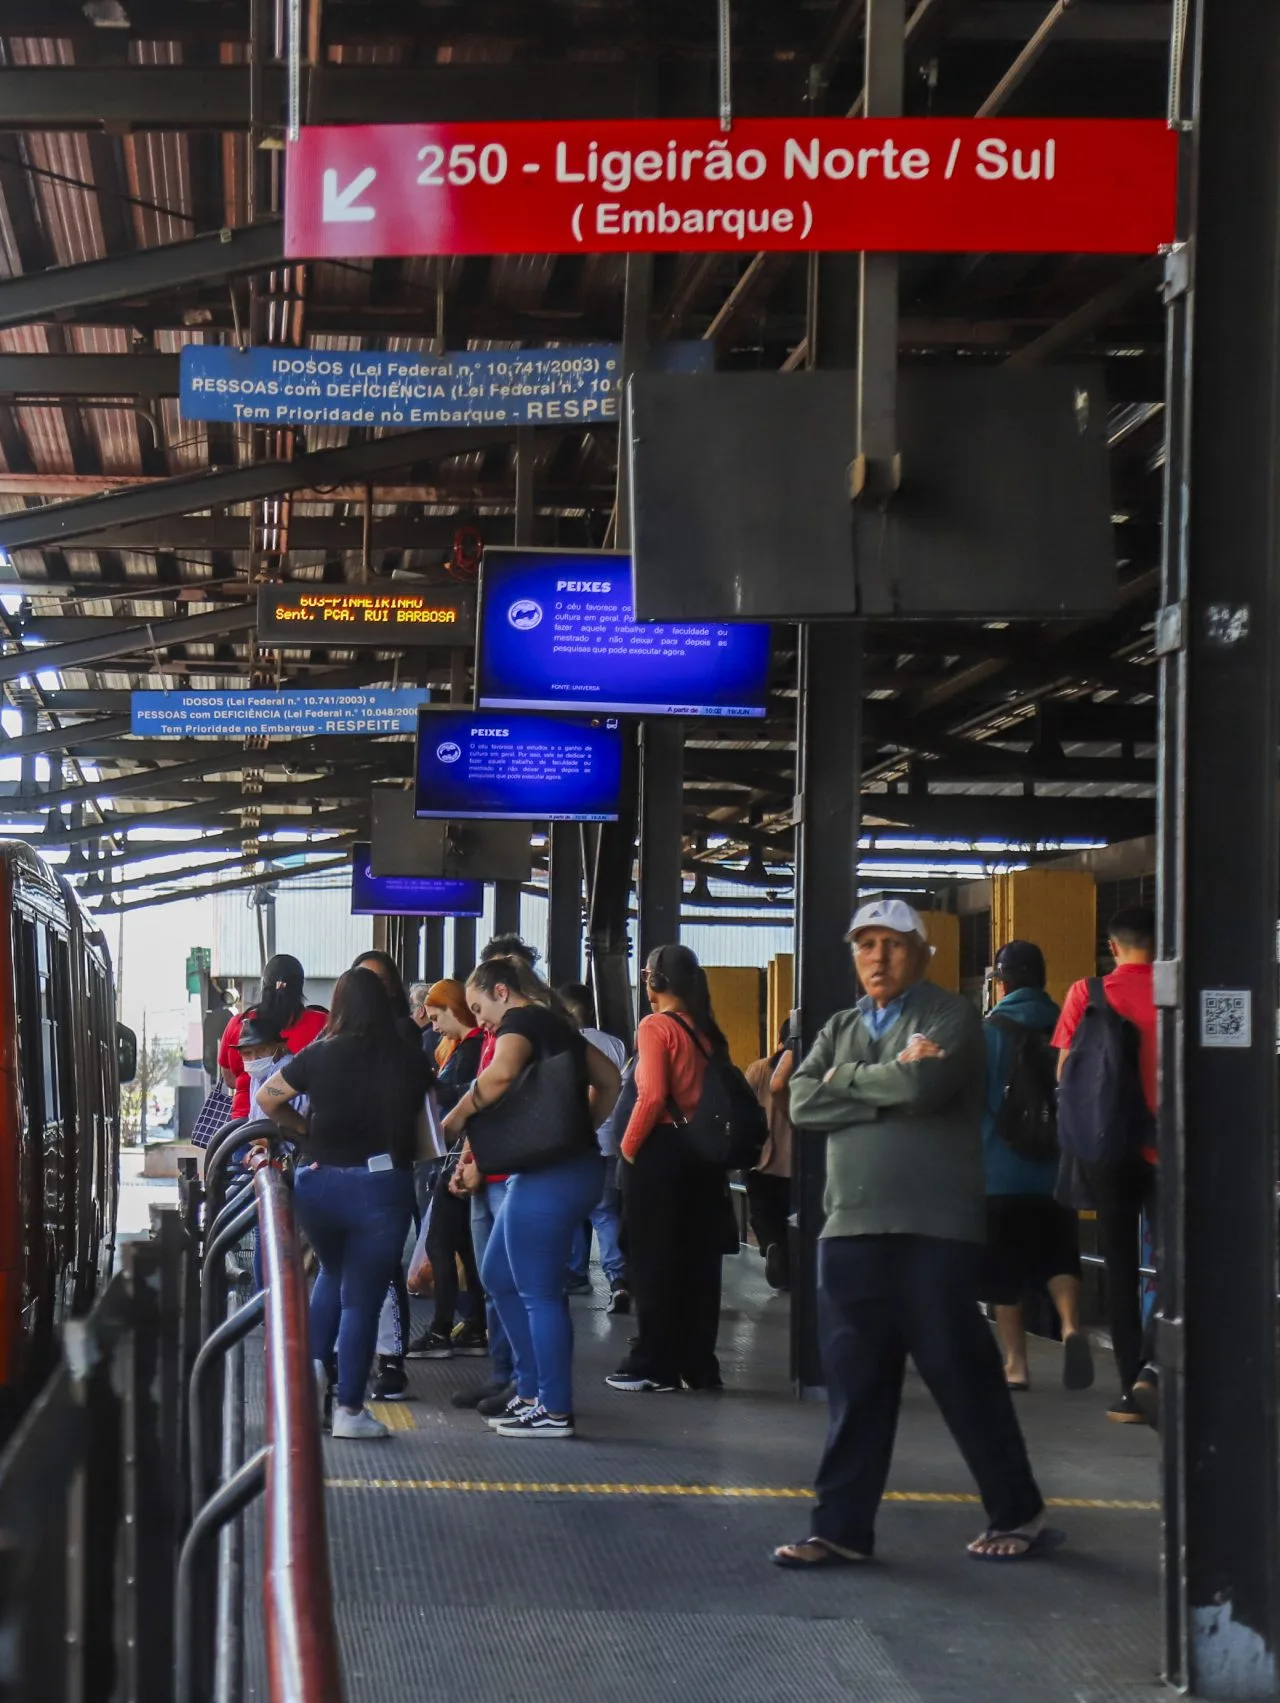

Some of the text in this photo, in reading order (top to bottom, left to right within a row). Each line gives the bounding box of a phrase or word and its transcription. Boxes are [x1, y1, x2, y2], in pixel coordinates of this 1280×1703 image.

[416, 143, 509, 186] 250
[555, 139, 768, 193] Ligeirão
[783, 138, 931, 181] Norte
[943, 137, 961, 181] /
[975, 138, 1056, 181] Sul
[272, 359, 343, 375] IDOSOS
[349, 363, 382, 378] (Lei
[387, 363, 453, 377] Federal
[487, 358, 600, 376] 10.741/2003)
[605, 359, 617, 371] e
[191, 378, 279, 395] PESSOAS
[284, 384, 321, 397] com
[326, 381, 446, 399] DEFICIÊNCIA
[489, 381, 556, 397] Federal
[233, 403, 270, 419] Tem
[276, 405, 375, 421] Prioridade
[380, 410, 404, 422] no
[410, 408, 507, 424] Embarque
[556, 580, 612, 593] PEIXES
[555, 601, 563, 610] O
[566, 602, 582, 611] céu
[585, 602, 618, 612] favorece
[275, 608, 315, 620] Sent.
[364, 609, 389, 622] RUI
[396, 610, 456, 623] BARBOSA
[554, 613, 581, 621] cultura
[554, 623, 573, 631] fazer
[580, 625, 607, 633] aquele
[615, 625, 646, 634] trabalho
[653, 626, 664, 634] de
[672, 626, 710, 636] faculdade
[553, 634, 590, 643] mestrado
[608, 635, 624, 643] não
[630, 636, 654, 644] deixar
[660, 638, 678, 646] para
[685, 638, 711, 647] depois
[553, 644, 592, 653] pesquisas
[592, 646, 607, 654] que
[608, 646, 628, 655] pode
[628, 647, 661, 656] executar
[182, 697, 224, 706] IDOSOS
[226, 697, 245, 708] (Lei
[247, 697, 285, 706] Federal
[303, 695, 367, 706] 10.741/2003)
[137, 710, 187, 719] PESSOAS
[213, 708, 281, 719] DEFICIÊNCIA
[283, 709, 303, 720] (Lei
[305, 709, 343, 718] Federal
[161, 724, 182, 733] Tem
[185, 724, 241, 733] Prioridade
[260, 723, 316, 734] Embarque
[325, 719, 400, 732] RESPEITE
[470, 728, 510, 737] PEIXES
